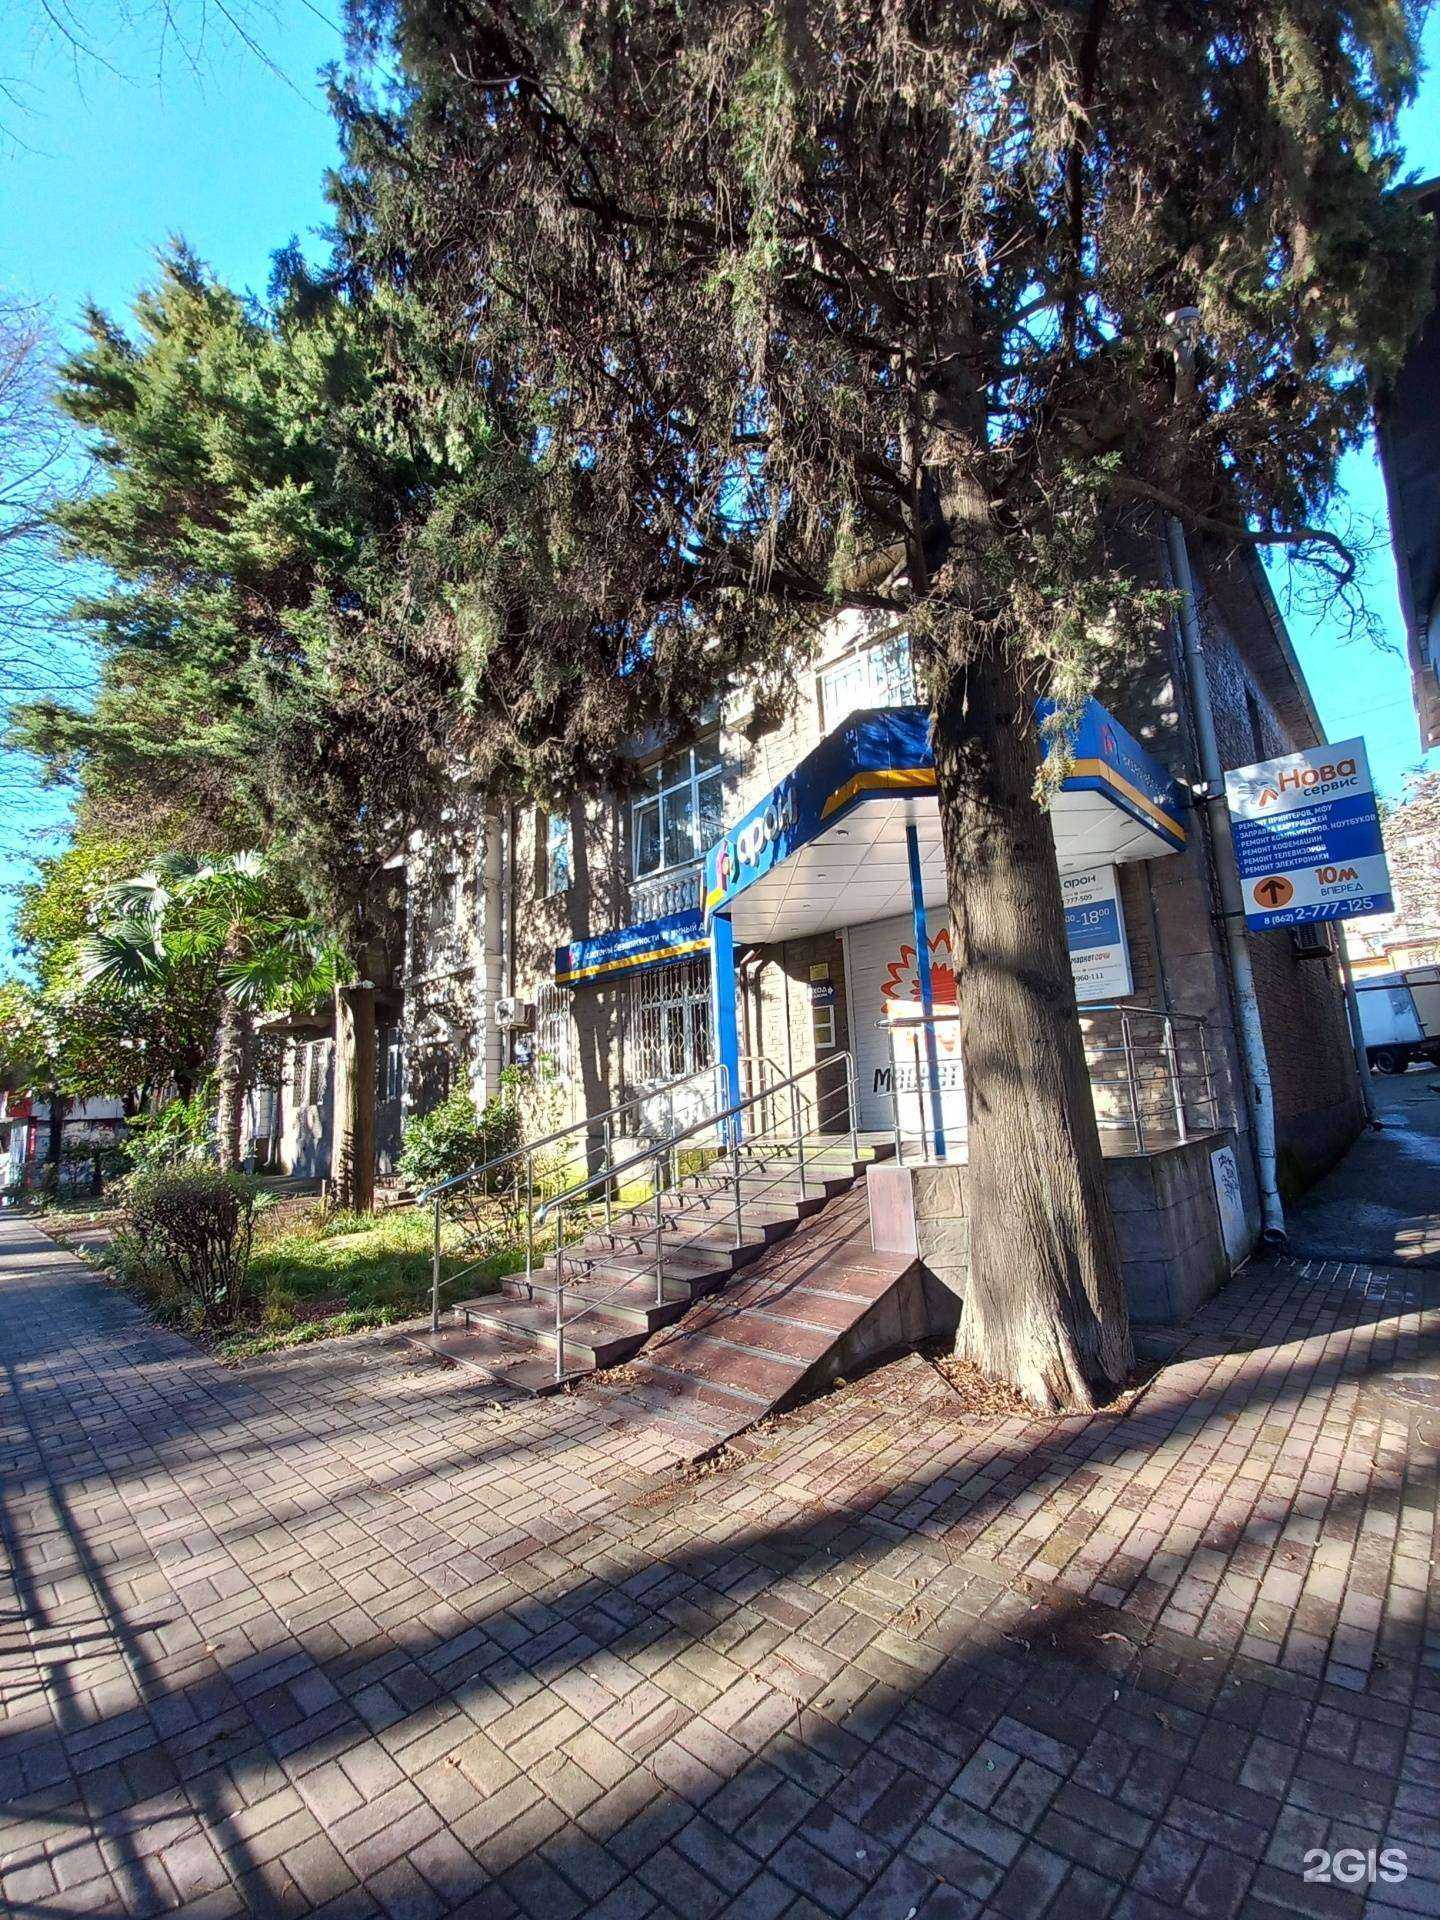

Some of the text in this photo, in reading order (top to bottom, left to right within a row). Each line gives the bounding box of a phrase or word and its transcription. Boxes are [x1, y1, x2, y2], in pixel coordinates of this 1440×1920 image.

[1278, 758, 1356, 791] Нова
[1303, 778, 1359, 797] сервис
[1238, 818, 1266, 831] РЕМОНТ
[1314, 804, 1333, 815] МФУ
[1241, 836, 1270, 848] РЕМОНТ
[1330, 813, 1377, 830] НОУТБУКОВ
[1242, 835, 1323, 857] РЕМОНТ КОФЕМАШИН
[1243, 843, 1327, 866] РЕМОНТ ТЕЛЕВИЗОРОВ
[1244, 852, 1330, 874] РЕМОНТ ЭЛЕКТРОНИКИ
[1321, 882, 1364, 896] ВПЕРЕД
[1264, 897, 1375, 926] 8 (862) 2-777-125
